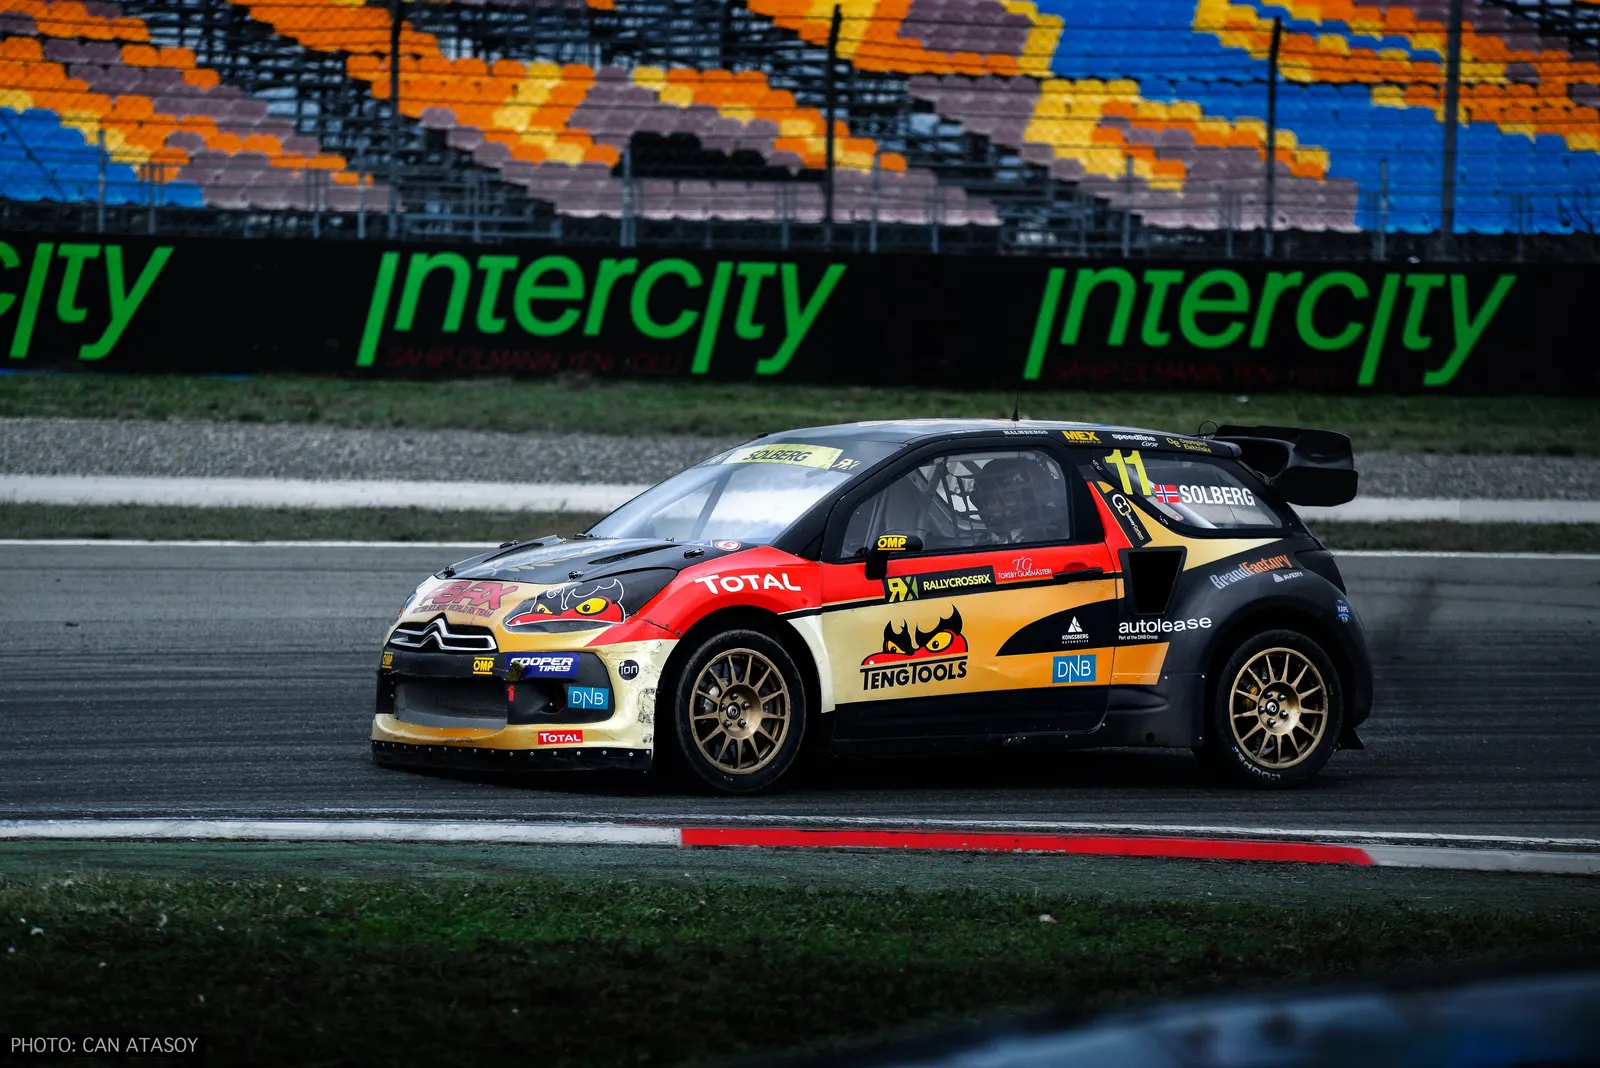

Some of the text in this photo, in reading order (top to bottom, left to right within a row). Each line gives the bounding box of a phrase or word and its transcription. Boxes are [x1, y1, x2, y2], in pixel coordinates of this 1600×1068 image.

[1062, 430, 1100, 441] MEX
[743, 449, 812, 463] SOLBERG
[1104, 449, 1152, 496] 11
[1180, 484, 1256, 506] SOLBERG
[877, 537, 907, 549] OMP
[1209, 554, 1293, 590] BrandFactory
[695, 573, 802, 595] TOTAL
[923, 573, 991, 591] RALLYCROSSRX
[476, 608, 494, 618] TEAM
[1118, 617, 1212, 634] autolease
[1062, 633, 1089, 641] KONGSBERG
[472, 660, 494, 672] OMP
[620, 662, 638, 675] ion
[1057, 655, 1091, 683] DNB
[572, 687, 604, 709] DNB
[540, 733, 581, 743] TOTAL
